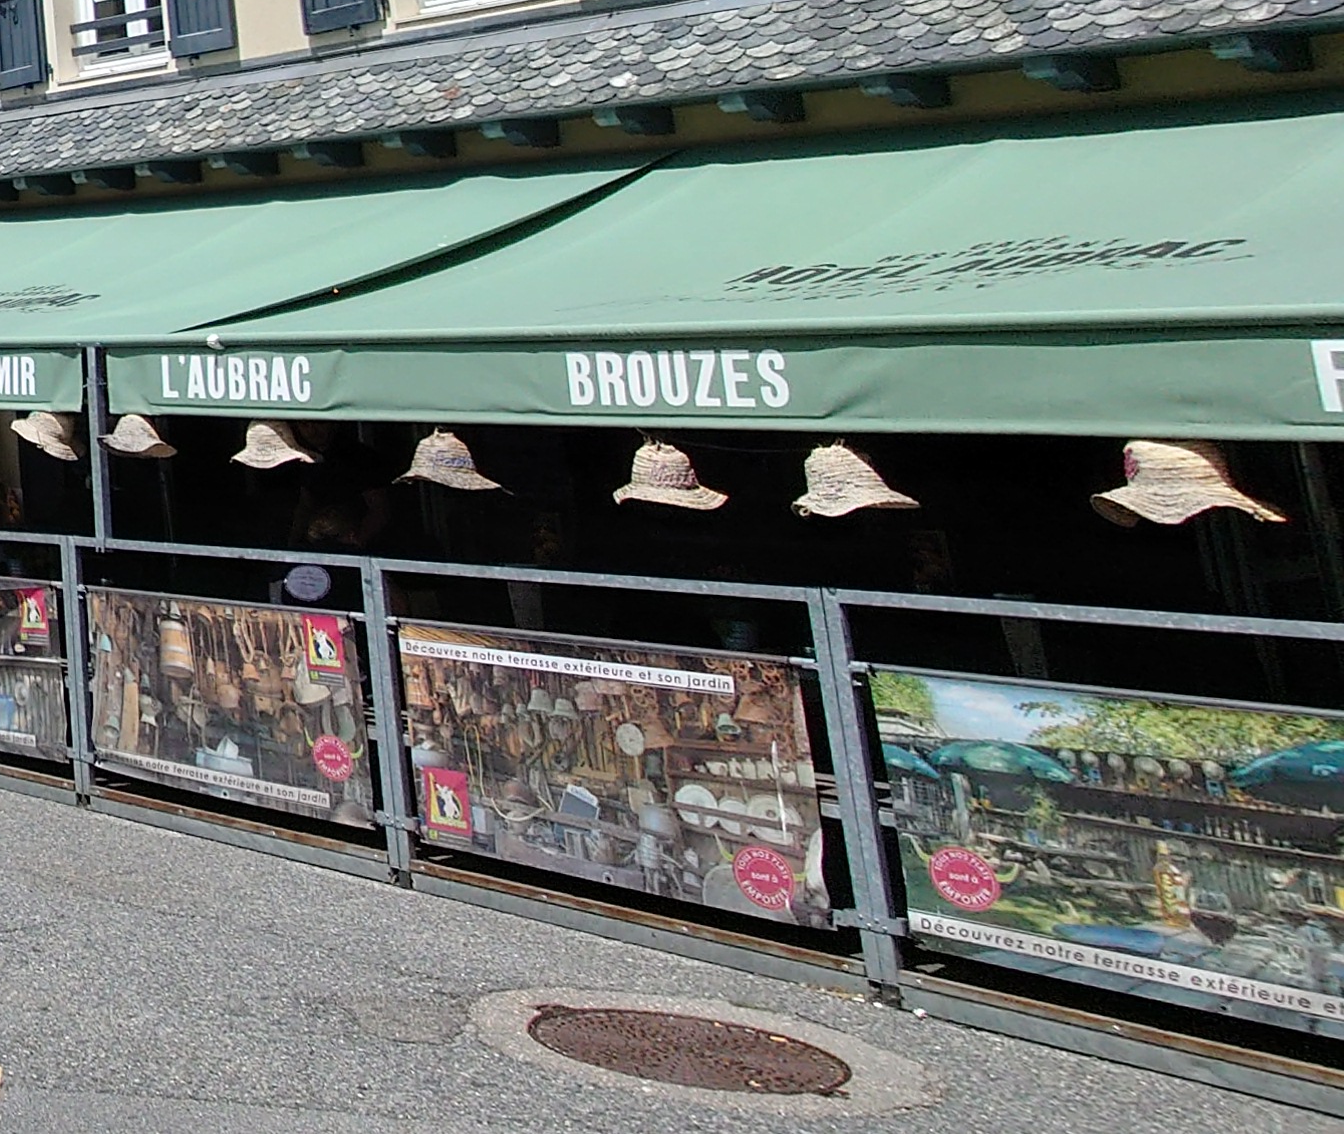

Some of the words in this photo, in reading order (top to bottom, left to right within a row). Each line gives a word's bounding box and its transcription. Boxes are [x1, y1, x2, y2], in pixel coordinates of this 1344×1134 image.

[724, 263, 926, 285] HÔTEL
[928, 238, 1246, 276] AUBRAC
[159, 354, 312, 403] L'AUBRAC
[565, 349, 789, 408] BROUZES
[405, 641, 468, 659] Découvrez
[472, 650, 503, 663] notre
[508, 654, 559, 670] terrasse
[564, 661, 633, 679] extérieure
[639, 670, 652, 681] et
[658, 674, 682, 685] son
[687, 673, 731, 691] jardin
[145, 760, 170, 772] notre
[173, 765, 209, 780] terrasse
[212, 773, 261, 792] extérieure
[276, 787, 295, 799] son
[296, 788, 328, 806] jardin
[920, 916, 1026, 949] Découvrez
[1032, 941, 1085, 963] notre
[1092, 952, 1181, 983] terrasse
[1190, 973, 1312, 1010] extérieure
